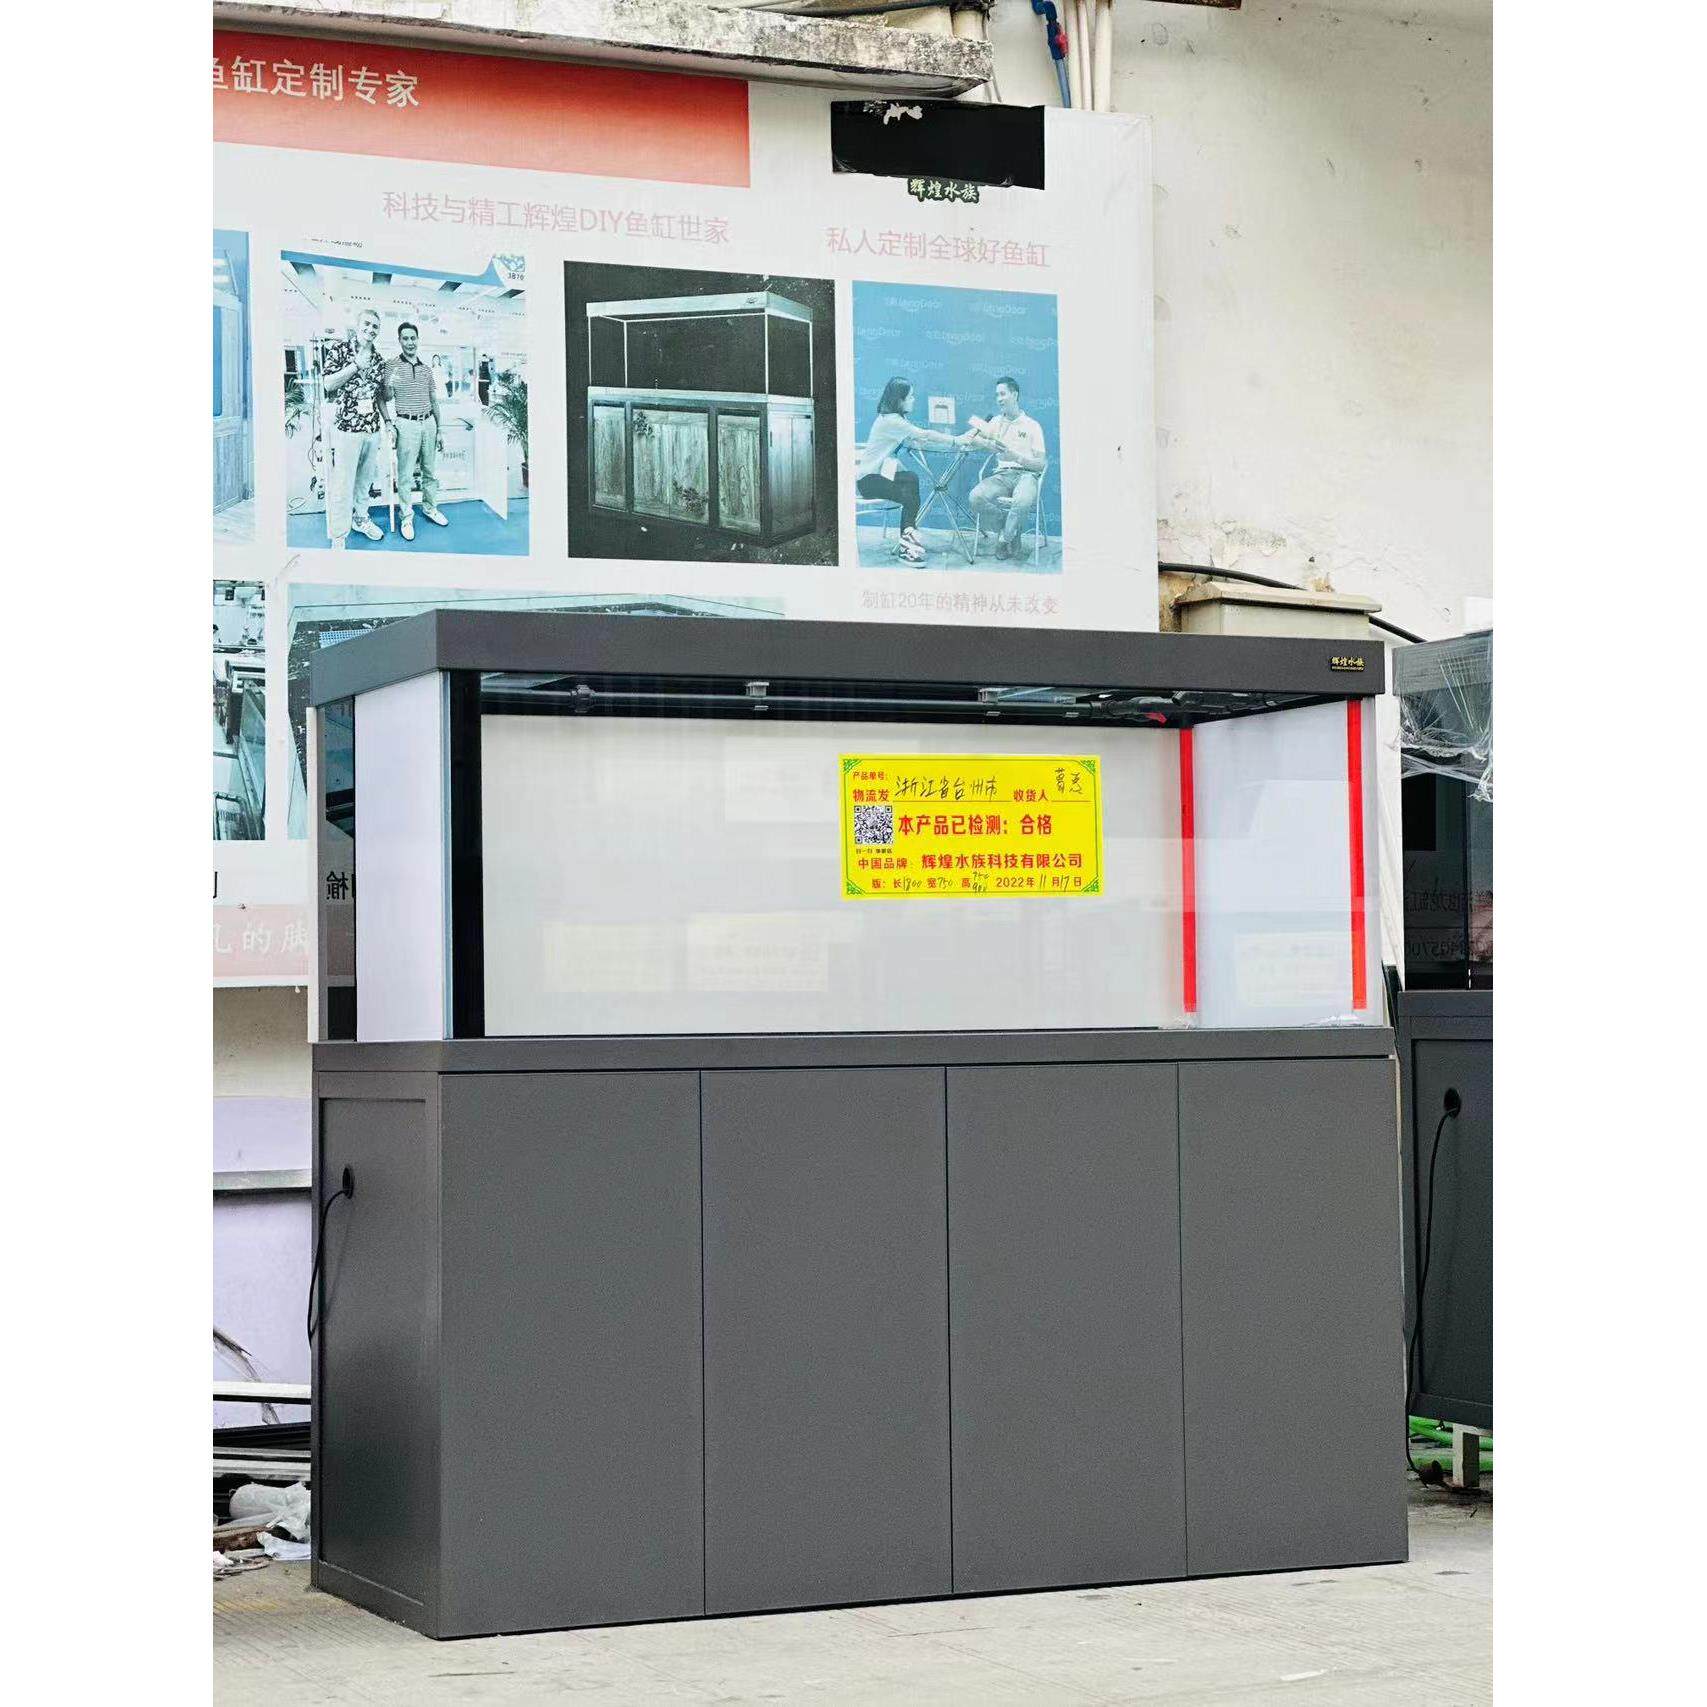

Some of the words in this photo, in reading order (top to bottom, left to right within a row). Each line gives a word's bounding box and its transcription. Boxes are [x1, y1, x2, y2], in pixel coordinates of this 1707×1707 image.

[909, 177, 978, 201] 辉煌水族
[382, 191, 730, 244] 科技与精工辉煌DIY鱼缸世家
[826, 226, 1051, 267] 私人定制全球好鱼缸
[862, 591, 1059, 615] 制缸20年的精神从未改变
[852, 789, 890, 802] 物流发
[1013, 788, 1049, 802] 收货人
[921, 853, 1082, 870] 辉煌水族科技有限公司
